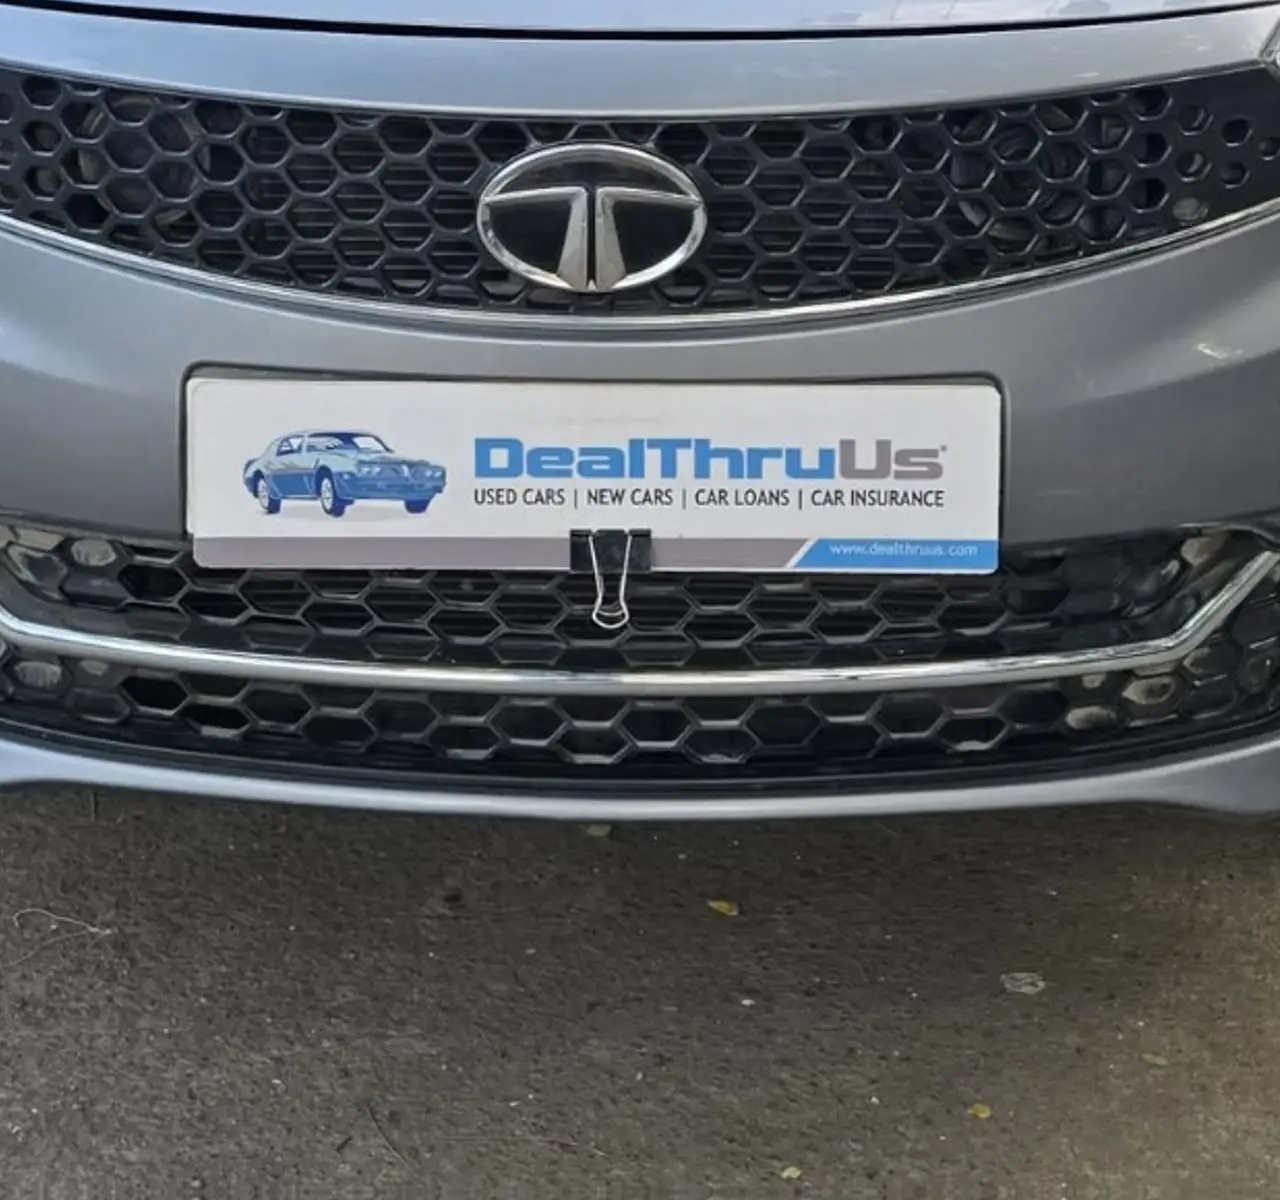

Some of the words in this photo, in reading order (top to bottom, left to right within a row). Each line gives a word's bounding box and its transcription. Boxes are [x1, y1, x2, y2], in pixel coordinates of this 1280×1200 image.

[474, 437, 946, 481] DealThruUs
[473, 487, 518, 506] USED
[521, 487, 566, 506] CARS
[586, 488, 626, 506] NEW
[629, 487, 674, 506] CARS
[693, 487, 729, 506] CAR
[733, 488, 790, 506] LOANS
[810, 488, 846, 507] CAR
[850, 489, 945, 508] INSURANCE
[828, 540, 979, 557] www.dealthruus.com
